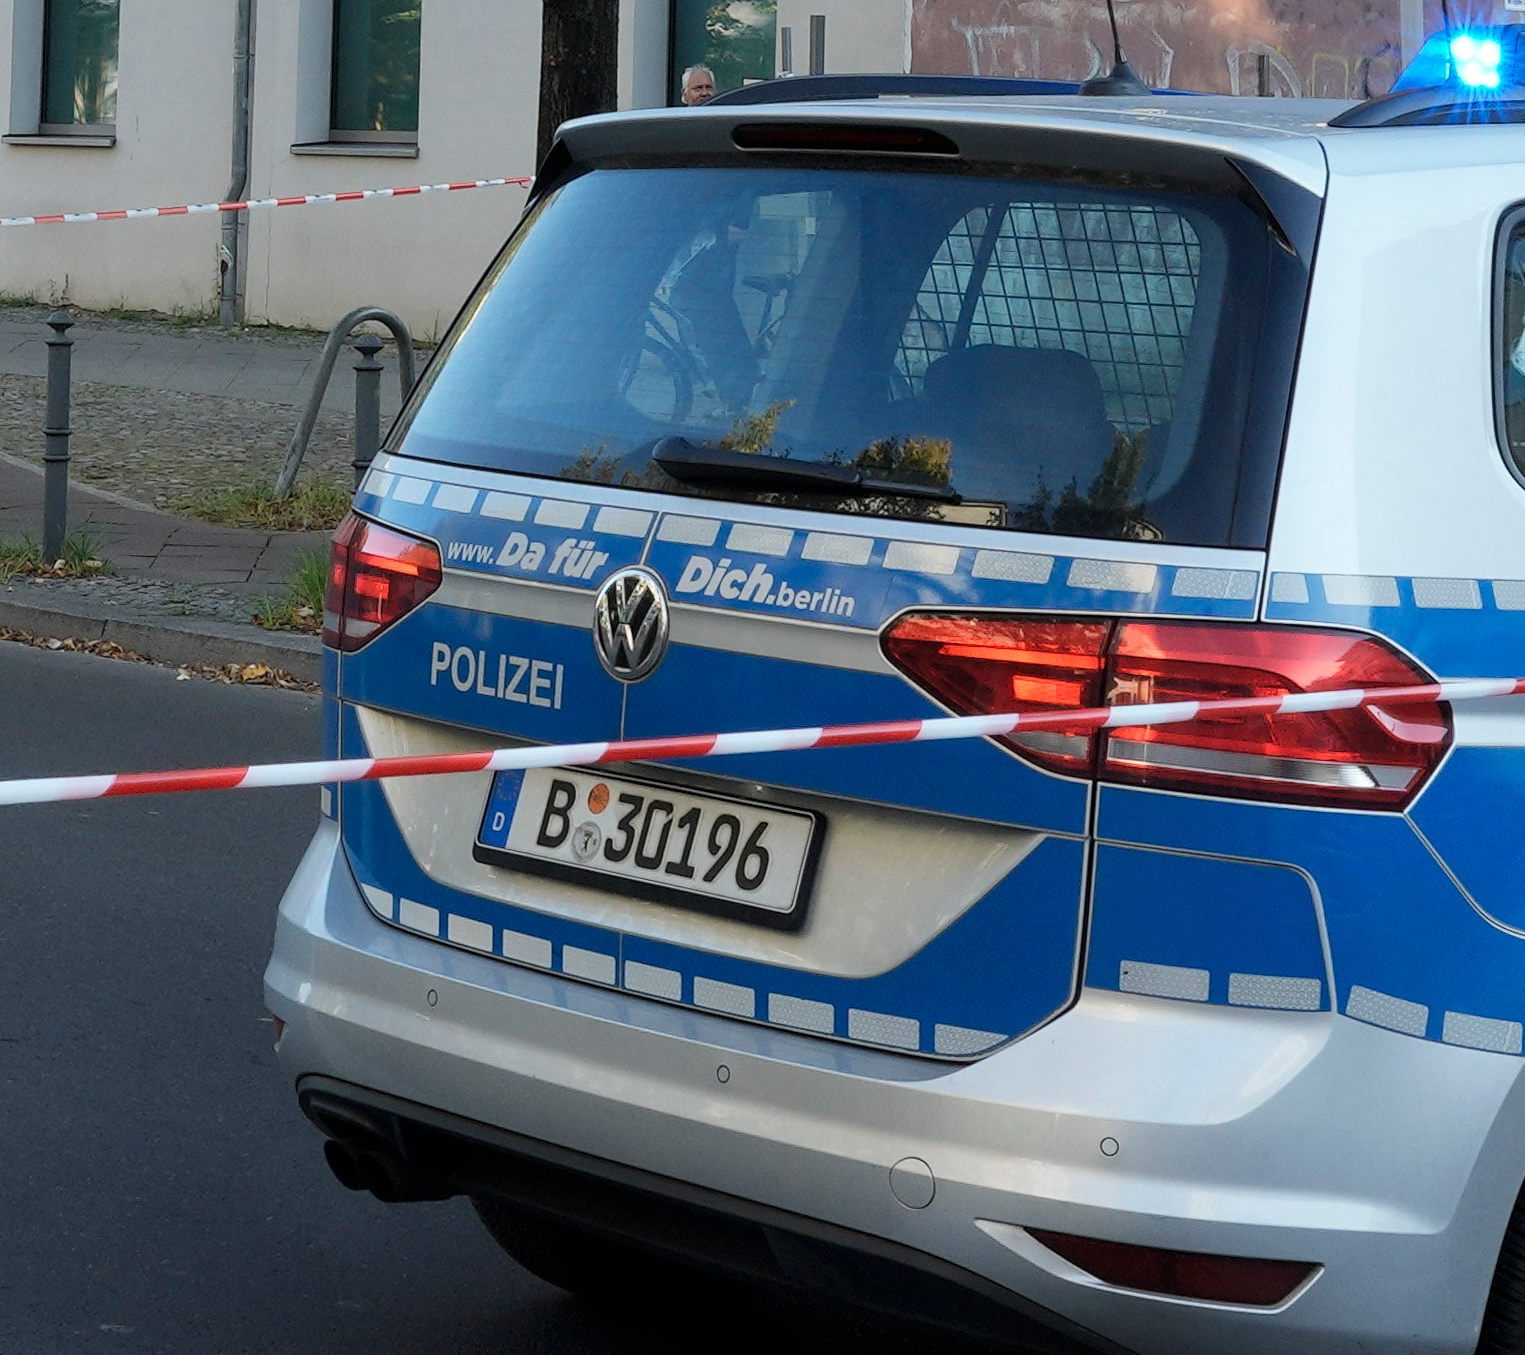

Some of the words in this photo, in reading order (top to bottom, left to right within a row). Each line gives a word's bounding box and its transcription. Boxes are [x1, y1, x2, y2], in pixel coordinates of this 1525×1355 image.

[549, 538, 610, 580] für
[675, 555, 856, 618] Dich.berlin
[429, 641, 565, 711] POLIZEI
[492, 811, 506, 832] D
[536, 778, 580, 849] B
[603, 790, 772, 892] 30196
